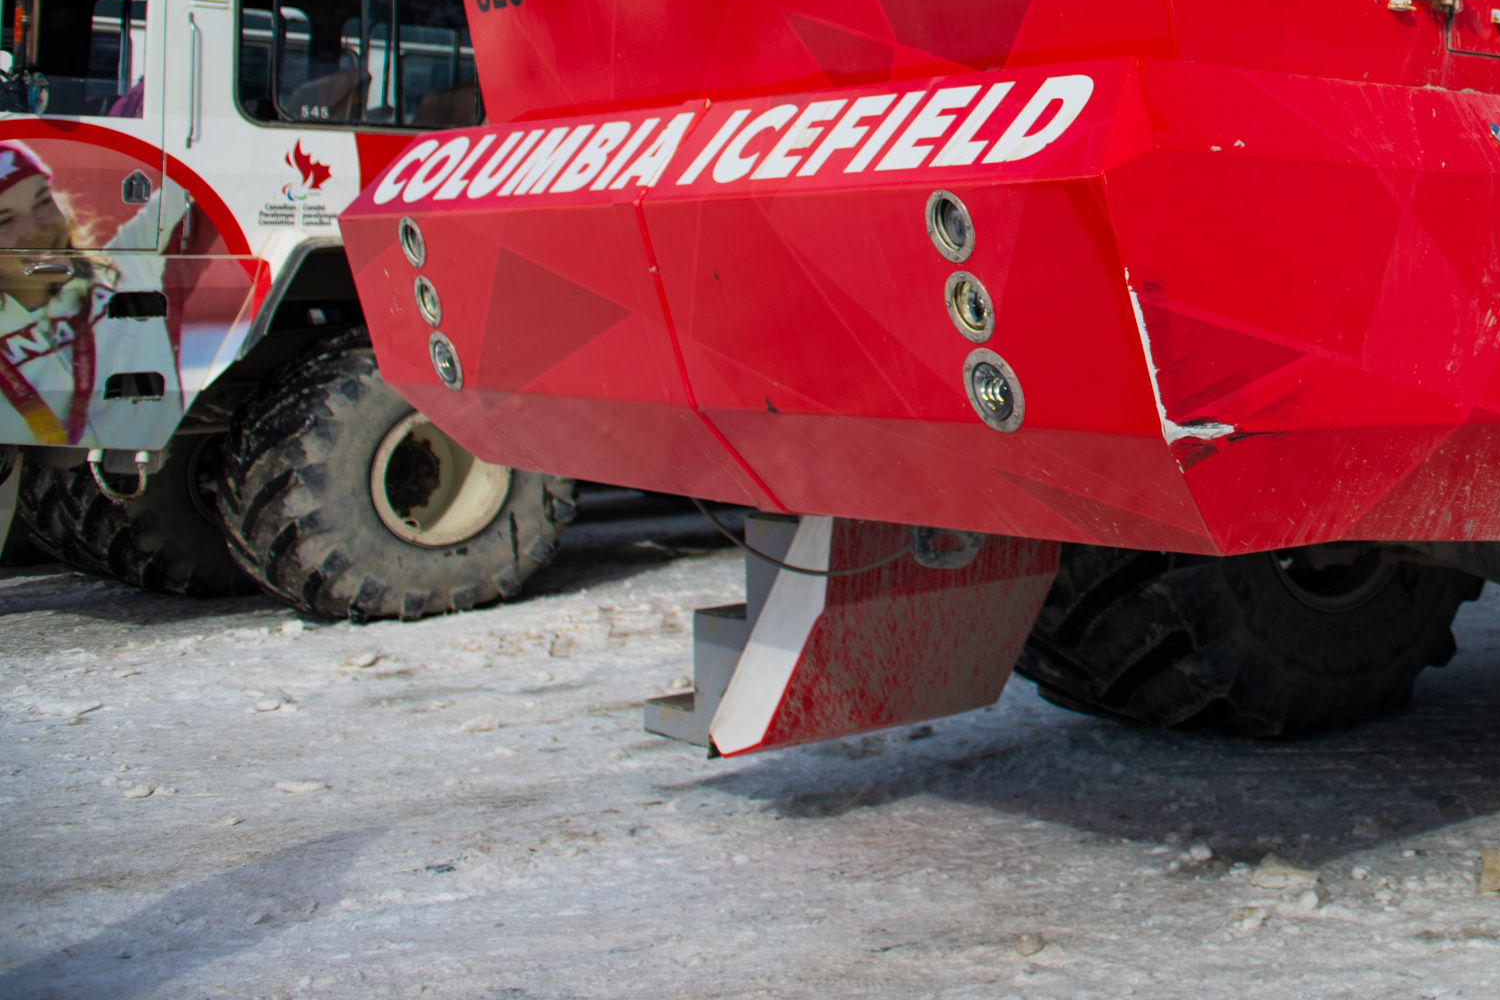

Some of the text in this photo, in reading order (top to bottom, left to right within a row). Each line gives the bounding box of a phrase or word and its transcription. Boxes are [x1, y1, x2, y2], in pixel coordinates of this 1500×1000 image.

[301, 105, 329, 119] 545
[374, 74, 1094, 205] COLUMBIA ICEFIELD
